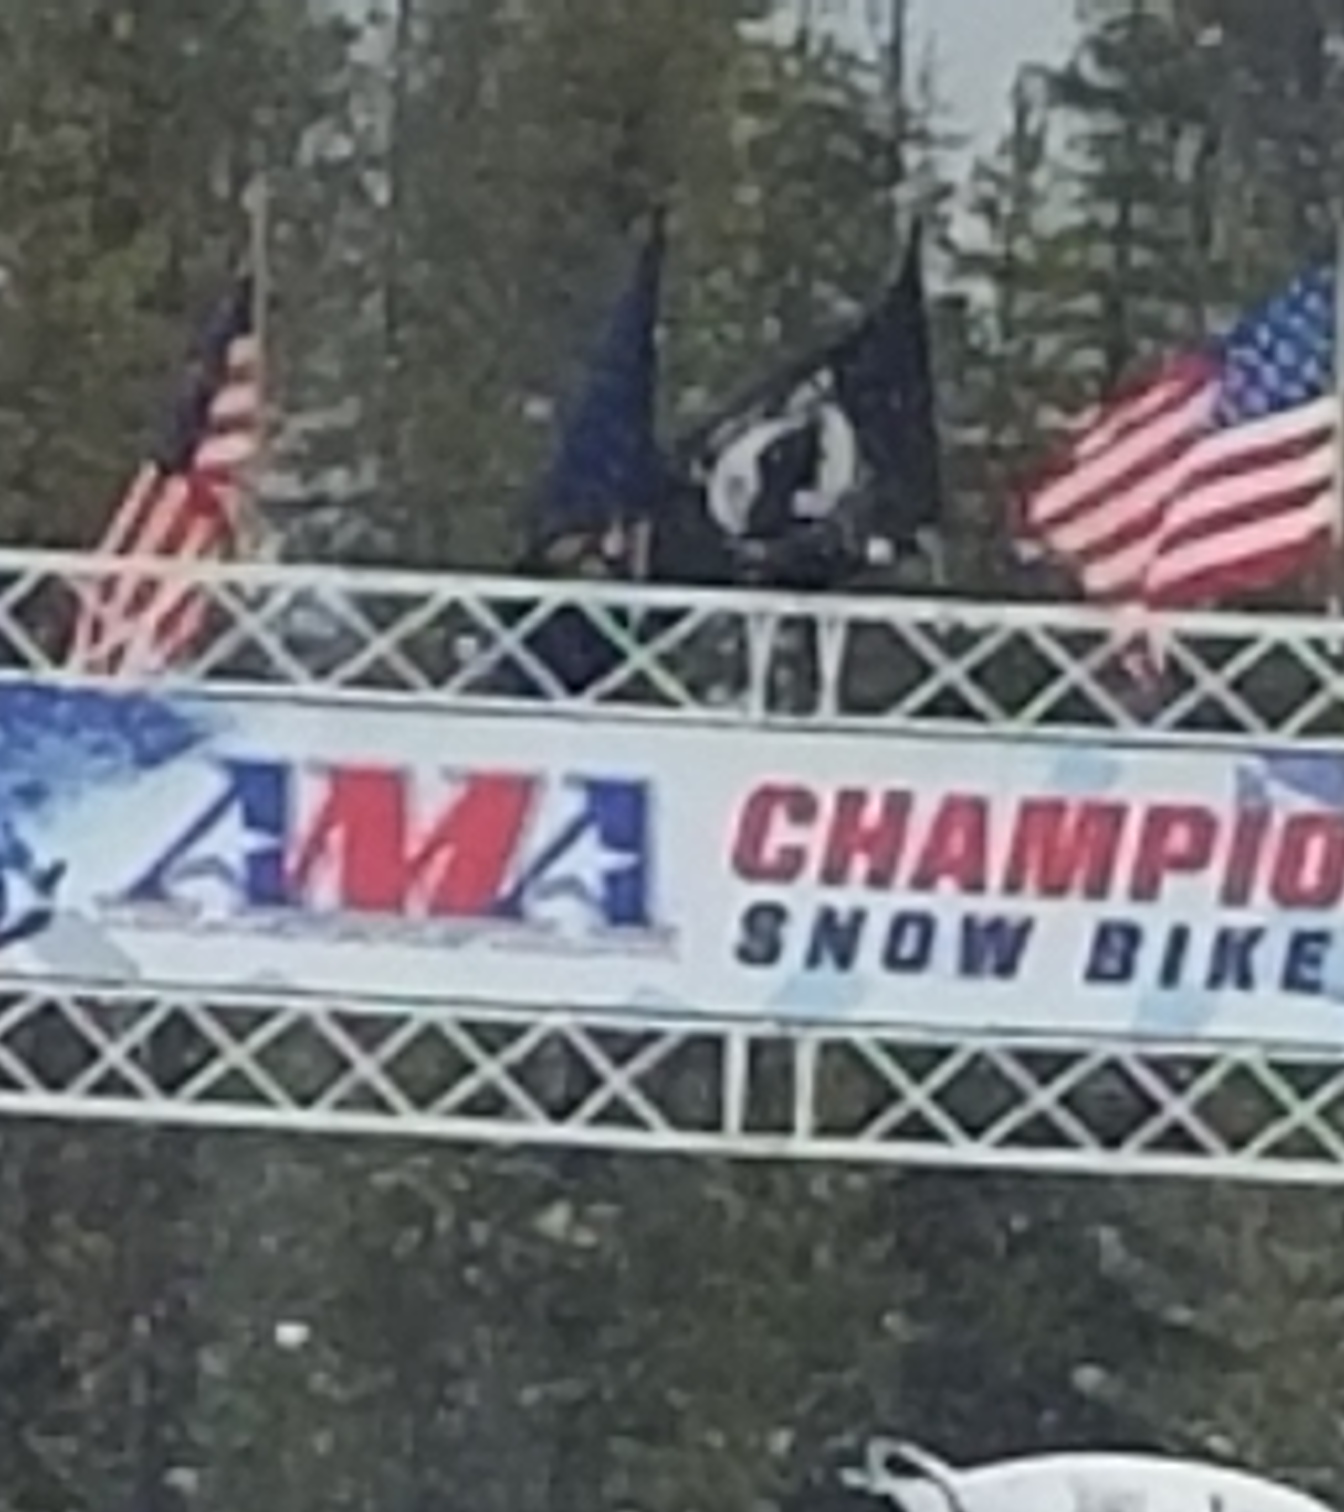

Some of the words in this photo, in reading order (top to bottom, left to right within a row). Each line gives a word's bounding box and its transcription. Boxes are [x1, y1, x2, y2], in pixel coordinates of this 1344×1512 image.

[126, 754, 653, 927] AMA
[734, 901, 1035, 981] SNOW
[1082, 918, 1332, 996] BIKE
